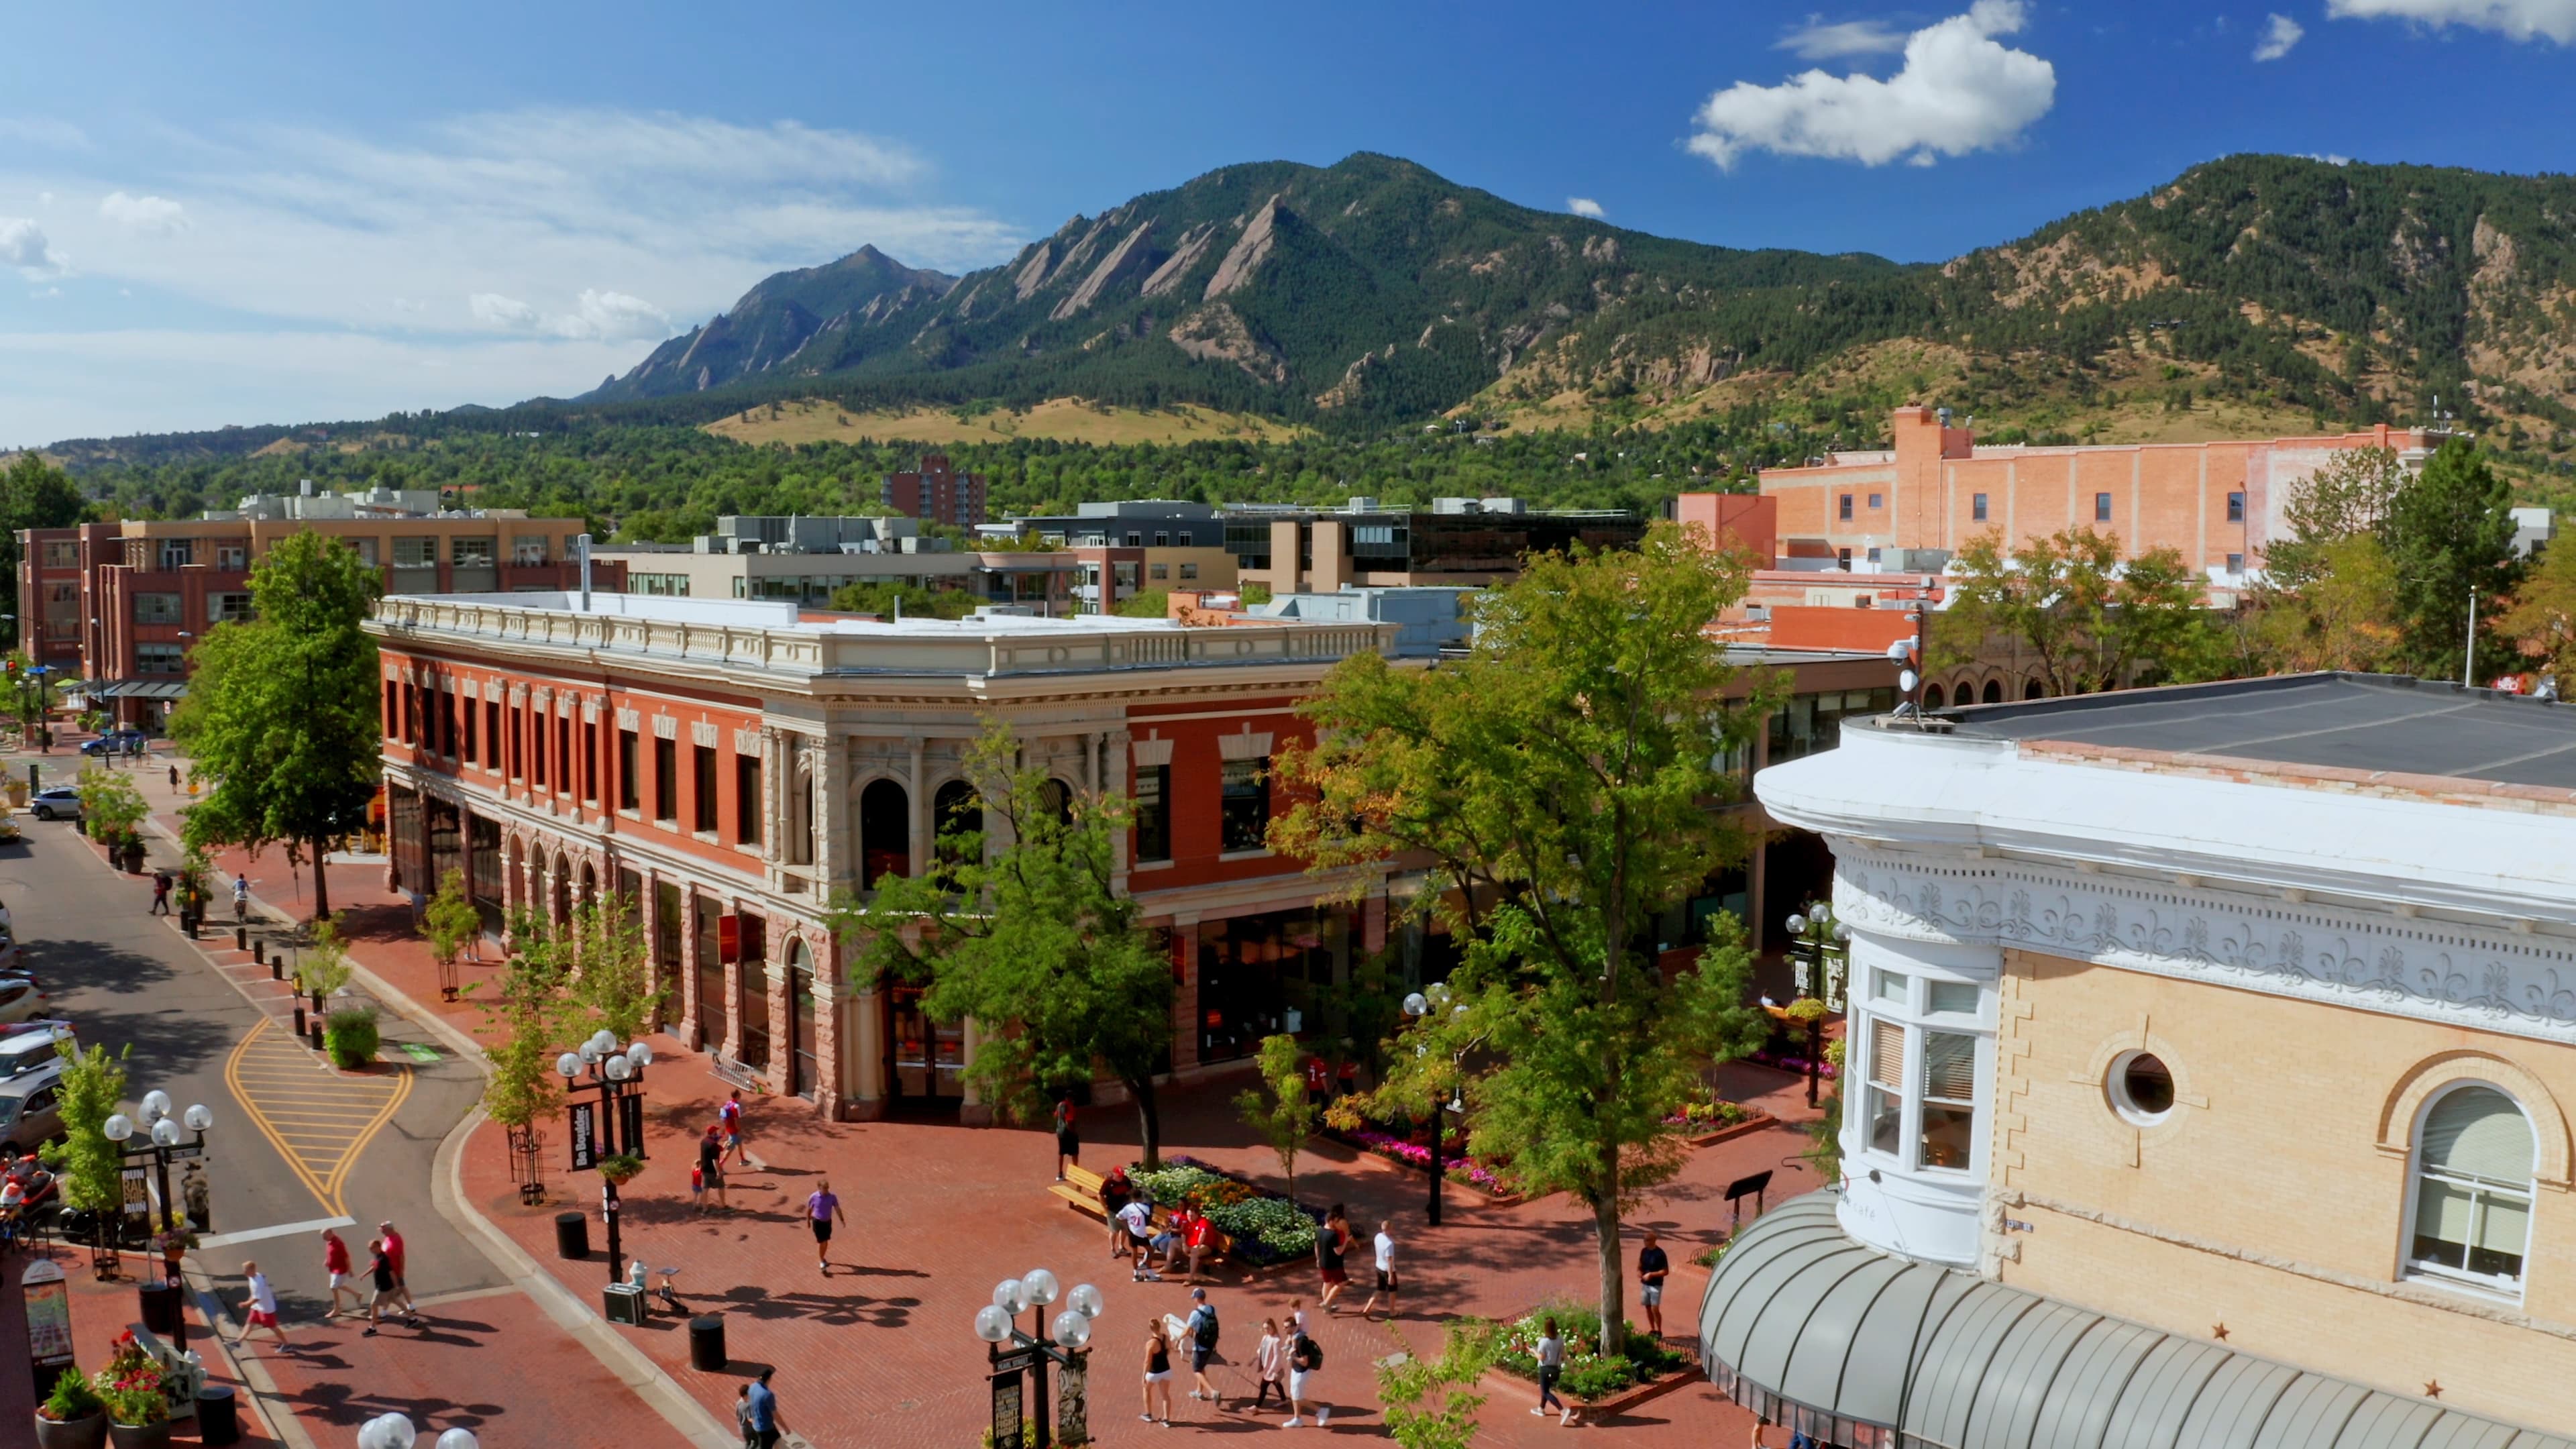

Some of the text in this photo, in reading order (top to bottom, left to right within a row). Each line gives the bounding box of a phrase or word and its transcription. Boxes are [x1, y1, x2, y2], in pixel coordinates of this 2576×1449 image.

[576, 1151, 587, 1167] Be
[122, 1169, 144, 1181] RUN
[123, 1179, 146, 1191] RAL
[124, 1191, 146, 1201] PHIE
[124, 1202, 147, 1214] RUN
[996, 1407, 1020, 1421] FIGHT
[996, 1415, 1020, 1430] FIGHT
[996, 1424, 1020, 1438] FIGHT
